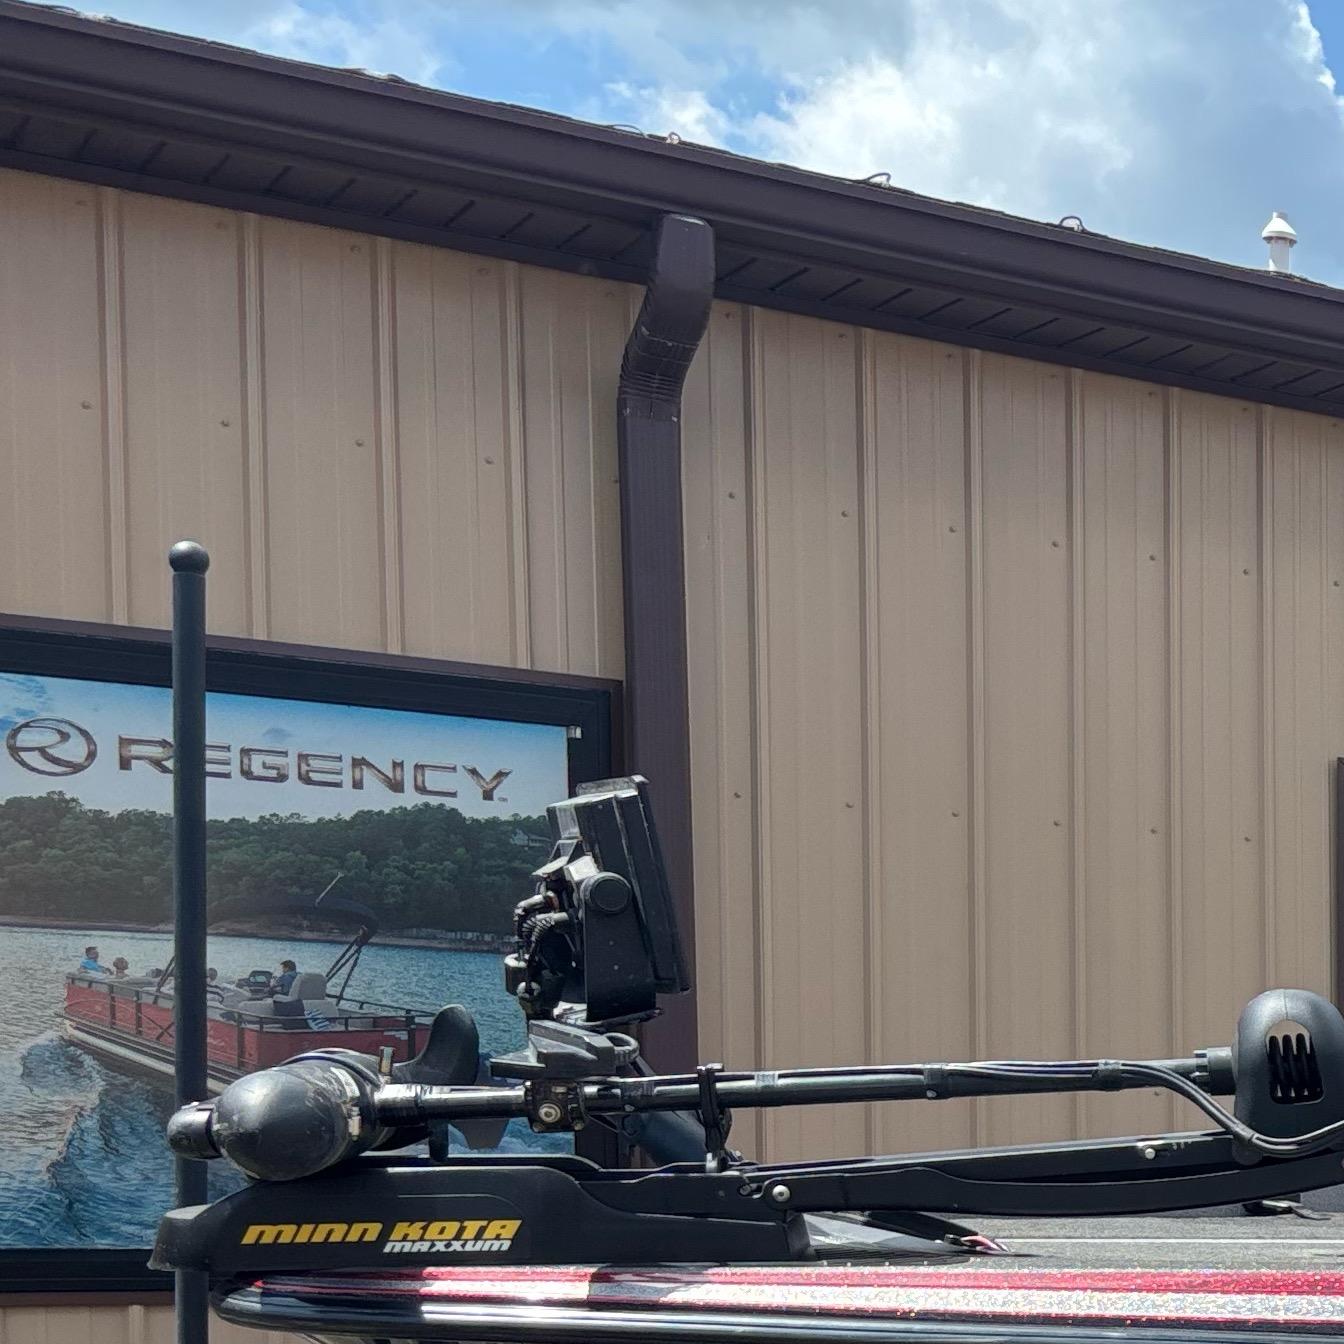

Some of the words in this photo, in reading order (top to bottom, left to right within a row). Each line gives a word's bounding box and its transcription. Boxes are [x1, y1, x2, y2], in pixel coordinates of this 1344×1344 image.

[117, 734, 513, 801] REGENCY
[240, 1222, 384, 1246] MINN
[388, 1219, 523, 1242] KOTA
[382, 1240, 512, 1254] MAXXUM
